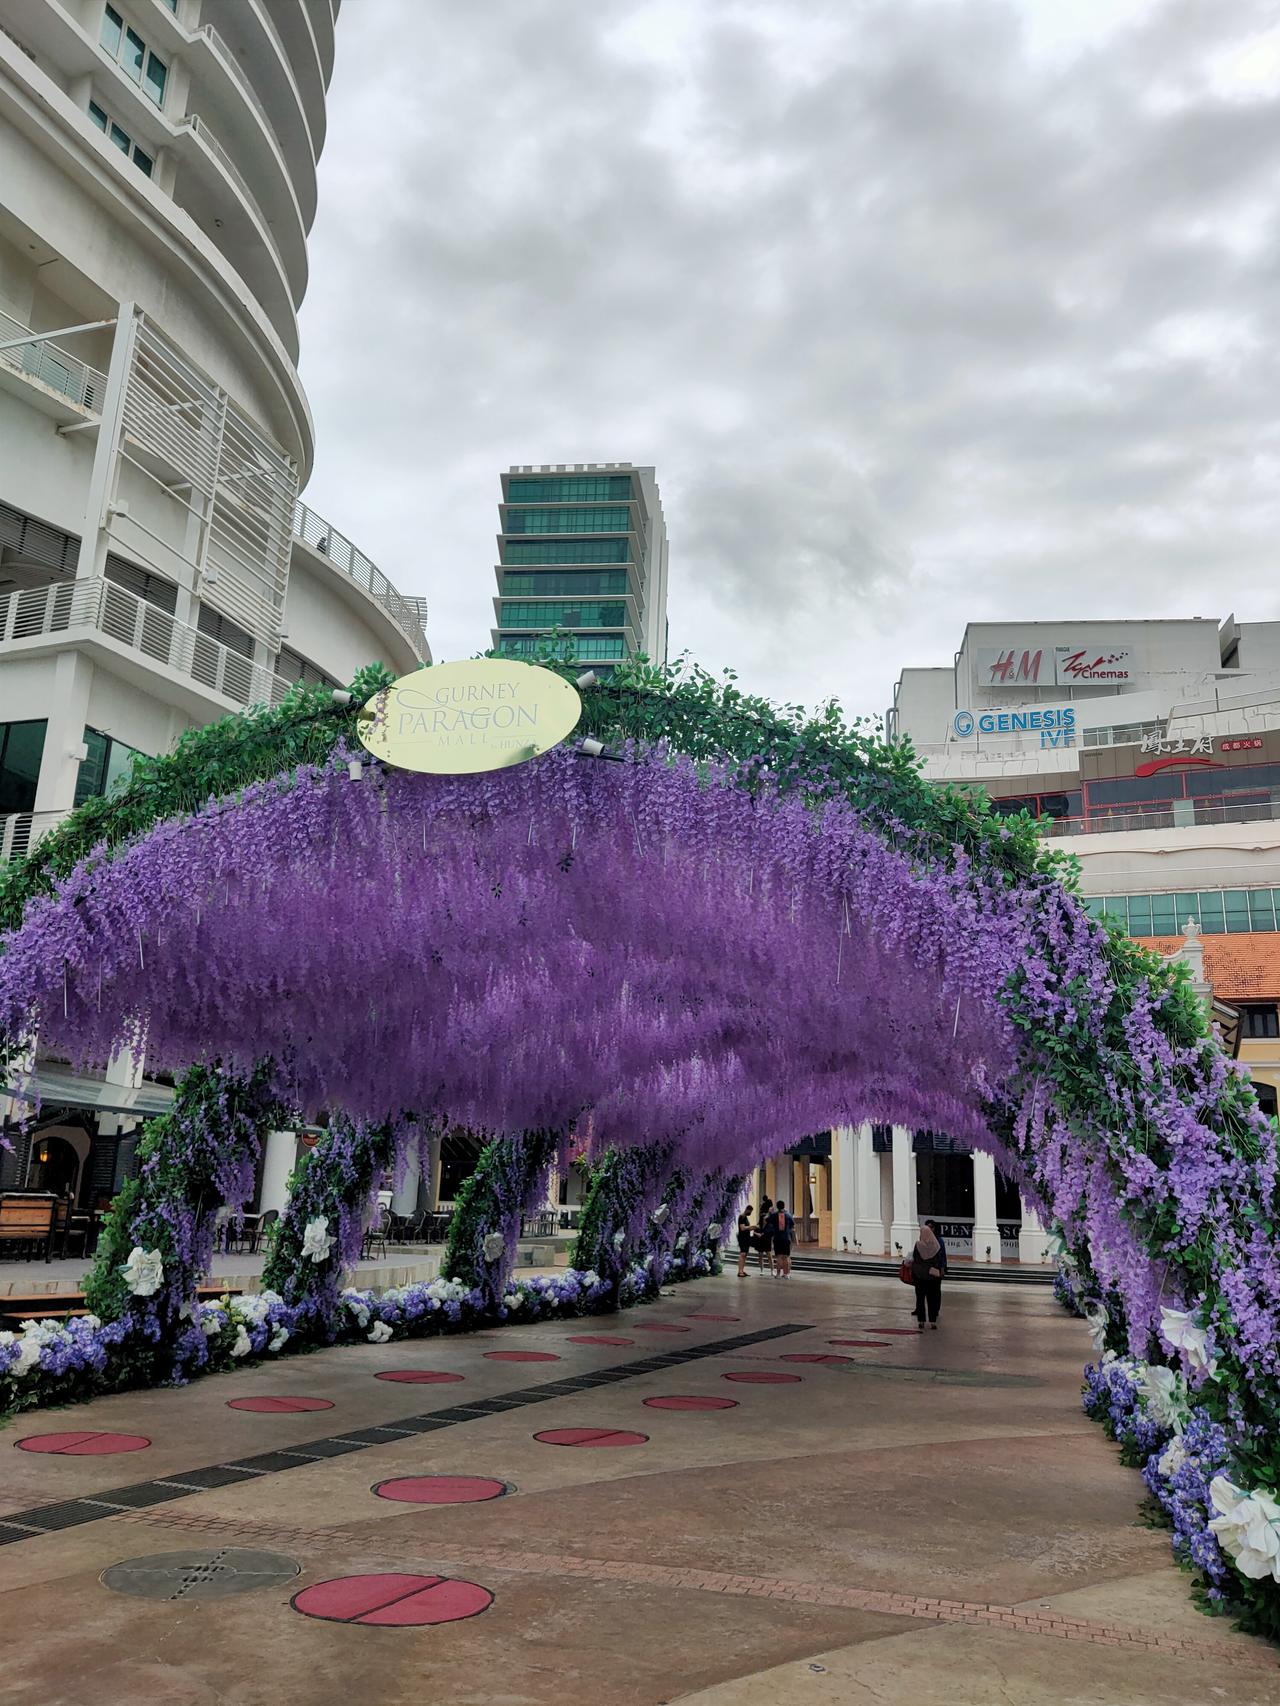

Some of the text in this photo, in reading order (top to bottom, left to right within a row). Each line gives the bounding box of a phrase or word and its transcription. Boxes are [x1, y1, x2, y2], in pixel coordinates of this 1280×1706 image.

[990, 649, 1043, 683] H&M
[1081, 669, 1129, 679] Cinemas
[436, 682, 519, 703] GURNEY
[399, 704, 537, 735] PARAGON
[979, 708, 1075, 733] GENESIS
[438, 734, 488, 746] MALL
[1040, 728, 1076, 750] IVF
